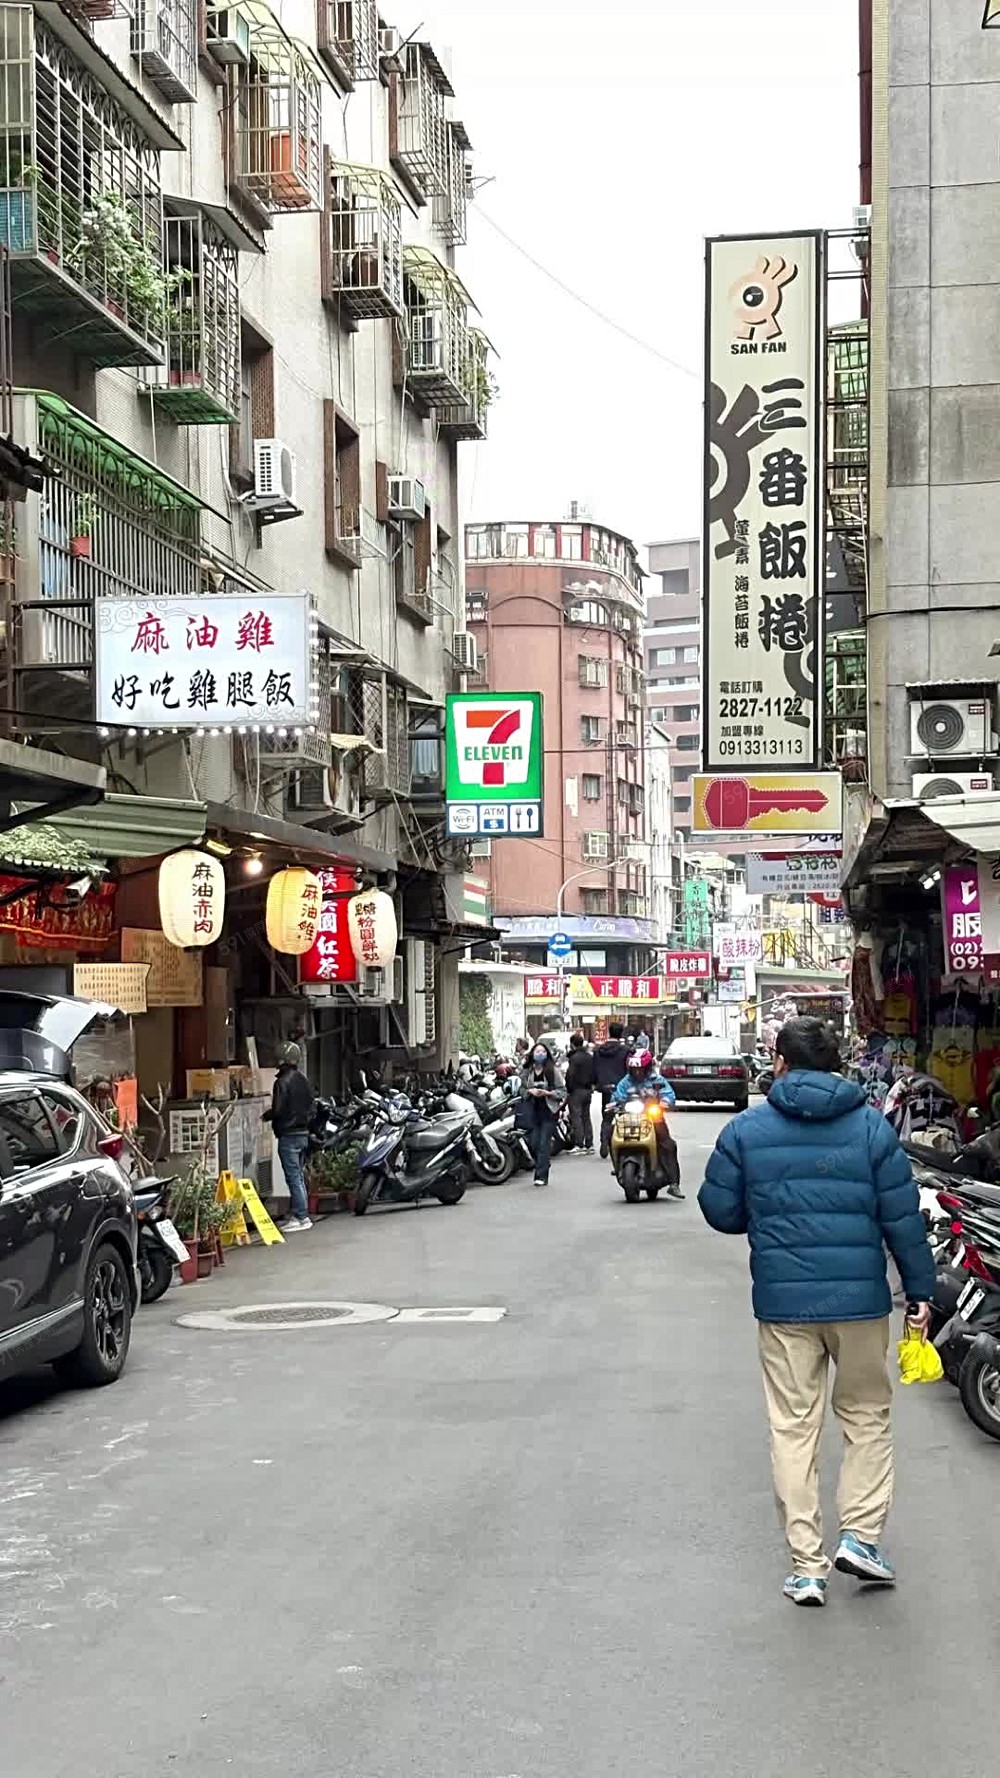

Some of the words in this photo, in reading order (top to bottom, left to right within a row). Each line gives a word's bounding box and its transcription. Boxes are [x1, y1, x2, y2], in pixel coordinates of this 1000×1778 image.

[731, 343, 758, 355] SAN
[762, 342, 787, 353] FAN
[757, 378, 809, 653] 三番飯捲
[734, 576, 750, 649] 海苔飯捲
[130, 610, 276, 654] 麻油雞
[112, 669, 296, 712] 好吃雞腿飯
[719, 681, 764, 694] 電話訂購
[719, 697, 803, 718] 2827-1122
[721, 725, 764, 737] 加盟專線
[719, 739, 803, 756] 0913313113
[484, 808, 505, 816] ATM
[191, 862, 215, 934] 麻油赤肉
[722, 937, 761, 958] 酸辣粉
